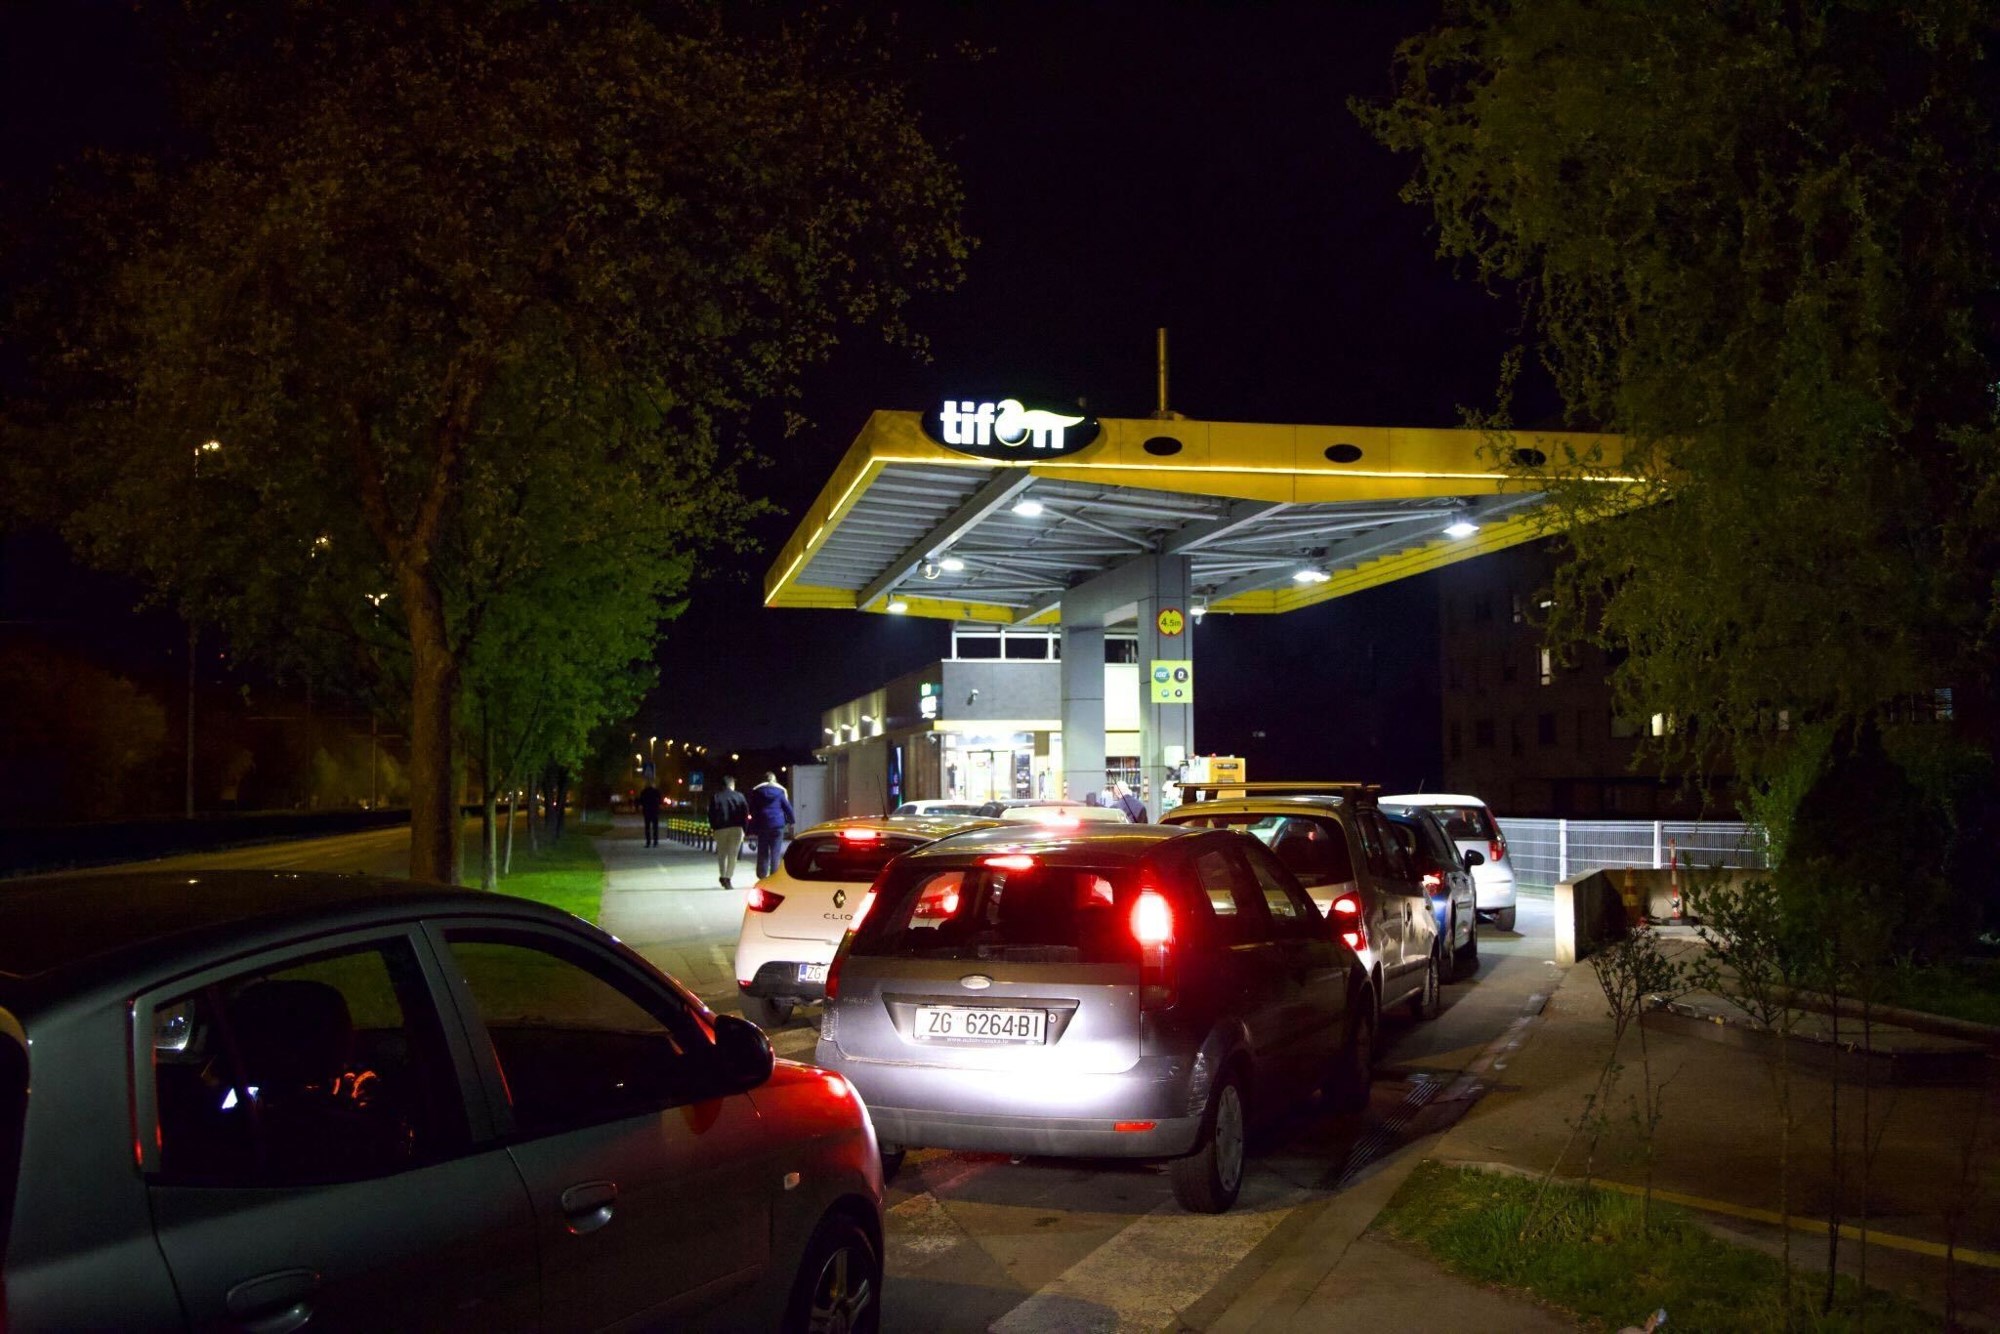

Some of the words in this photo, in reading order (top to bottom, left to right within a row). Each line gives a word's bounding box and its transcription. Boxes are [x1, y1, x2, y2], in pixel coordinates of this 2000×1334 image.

[940, 399, 1085, 449] tifon
[807, 967, 821, 979] ZG
[929, 1012, 952, 1033] ZG
